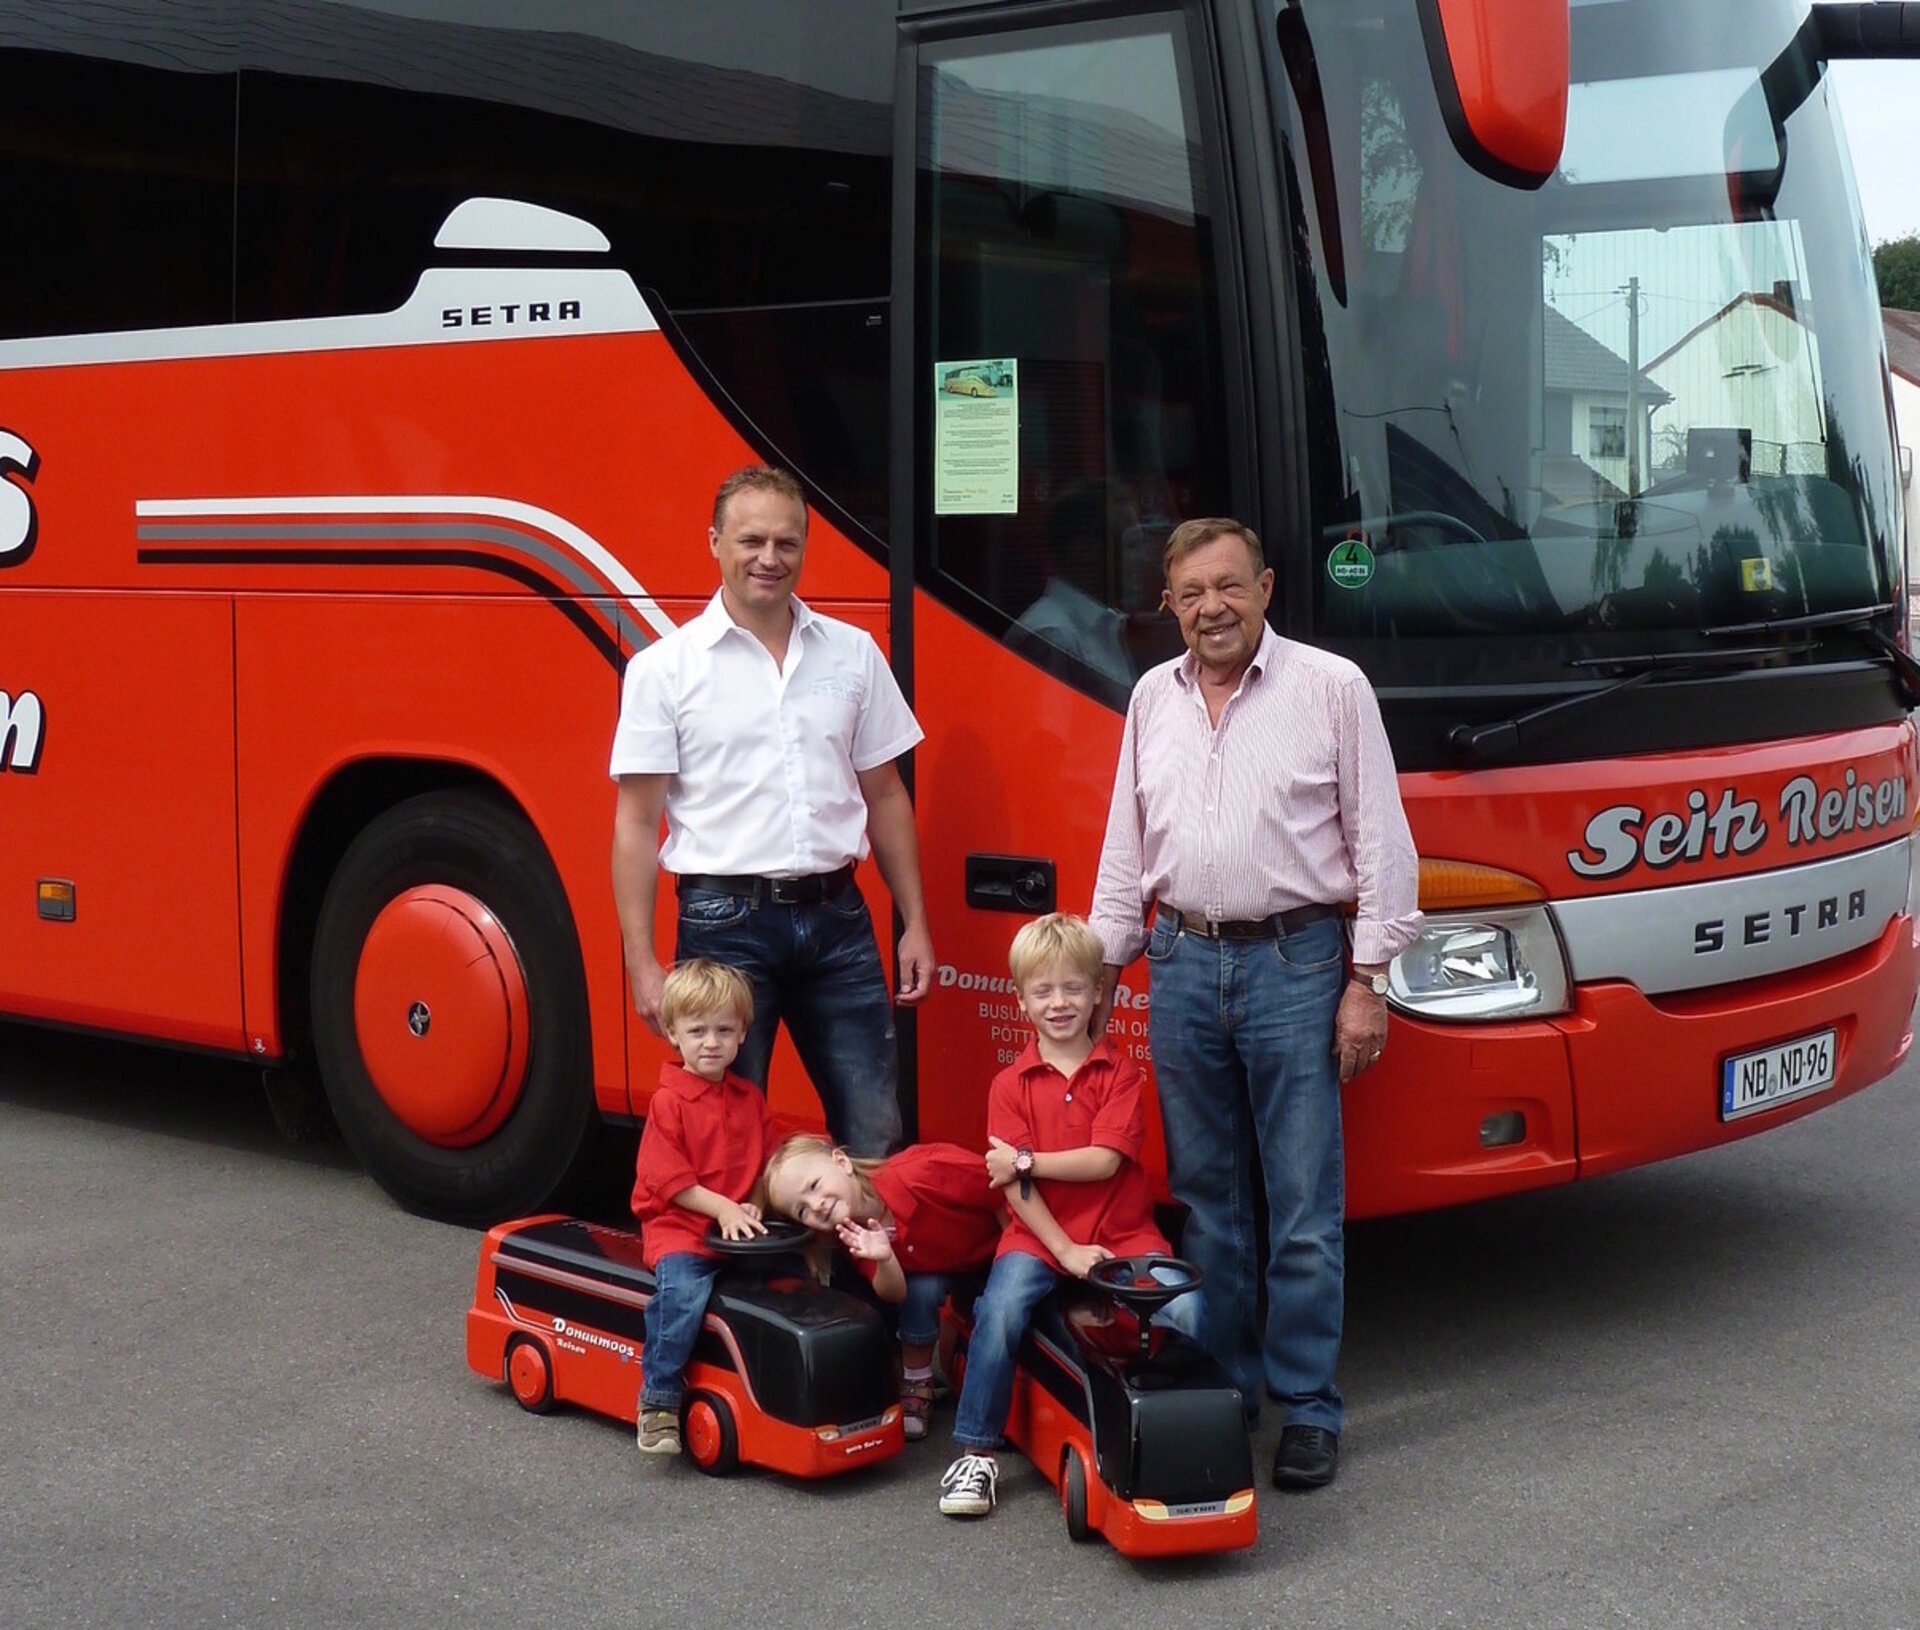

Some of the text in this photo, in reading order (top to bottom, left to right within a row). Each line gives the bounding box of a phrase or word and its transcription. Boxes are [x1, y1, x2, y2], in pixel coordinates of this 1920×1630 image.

[442, 300, 581, 328] SETRA
[1345, 543, 1358, 565] 4
[1567, 766, 1907, 880] Seitz Reisen
[1694, 889, 1866, 955] SETRA
[1742, 1058, 1768, 1101] ND
[556, 1337, 587, 1355] Reisen
